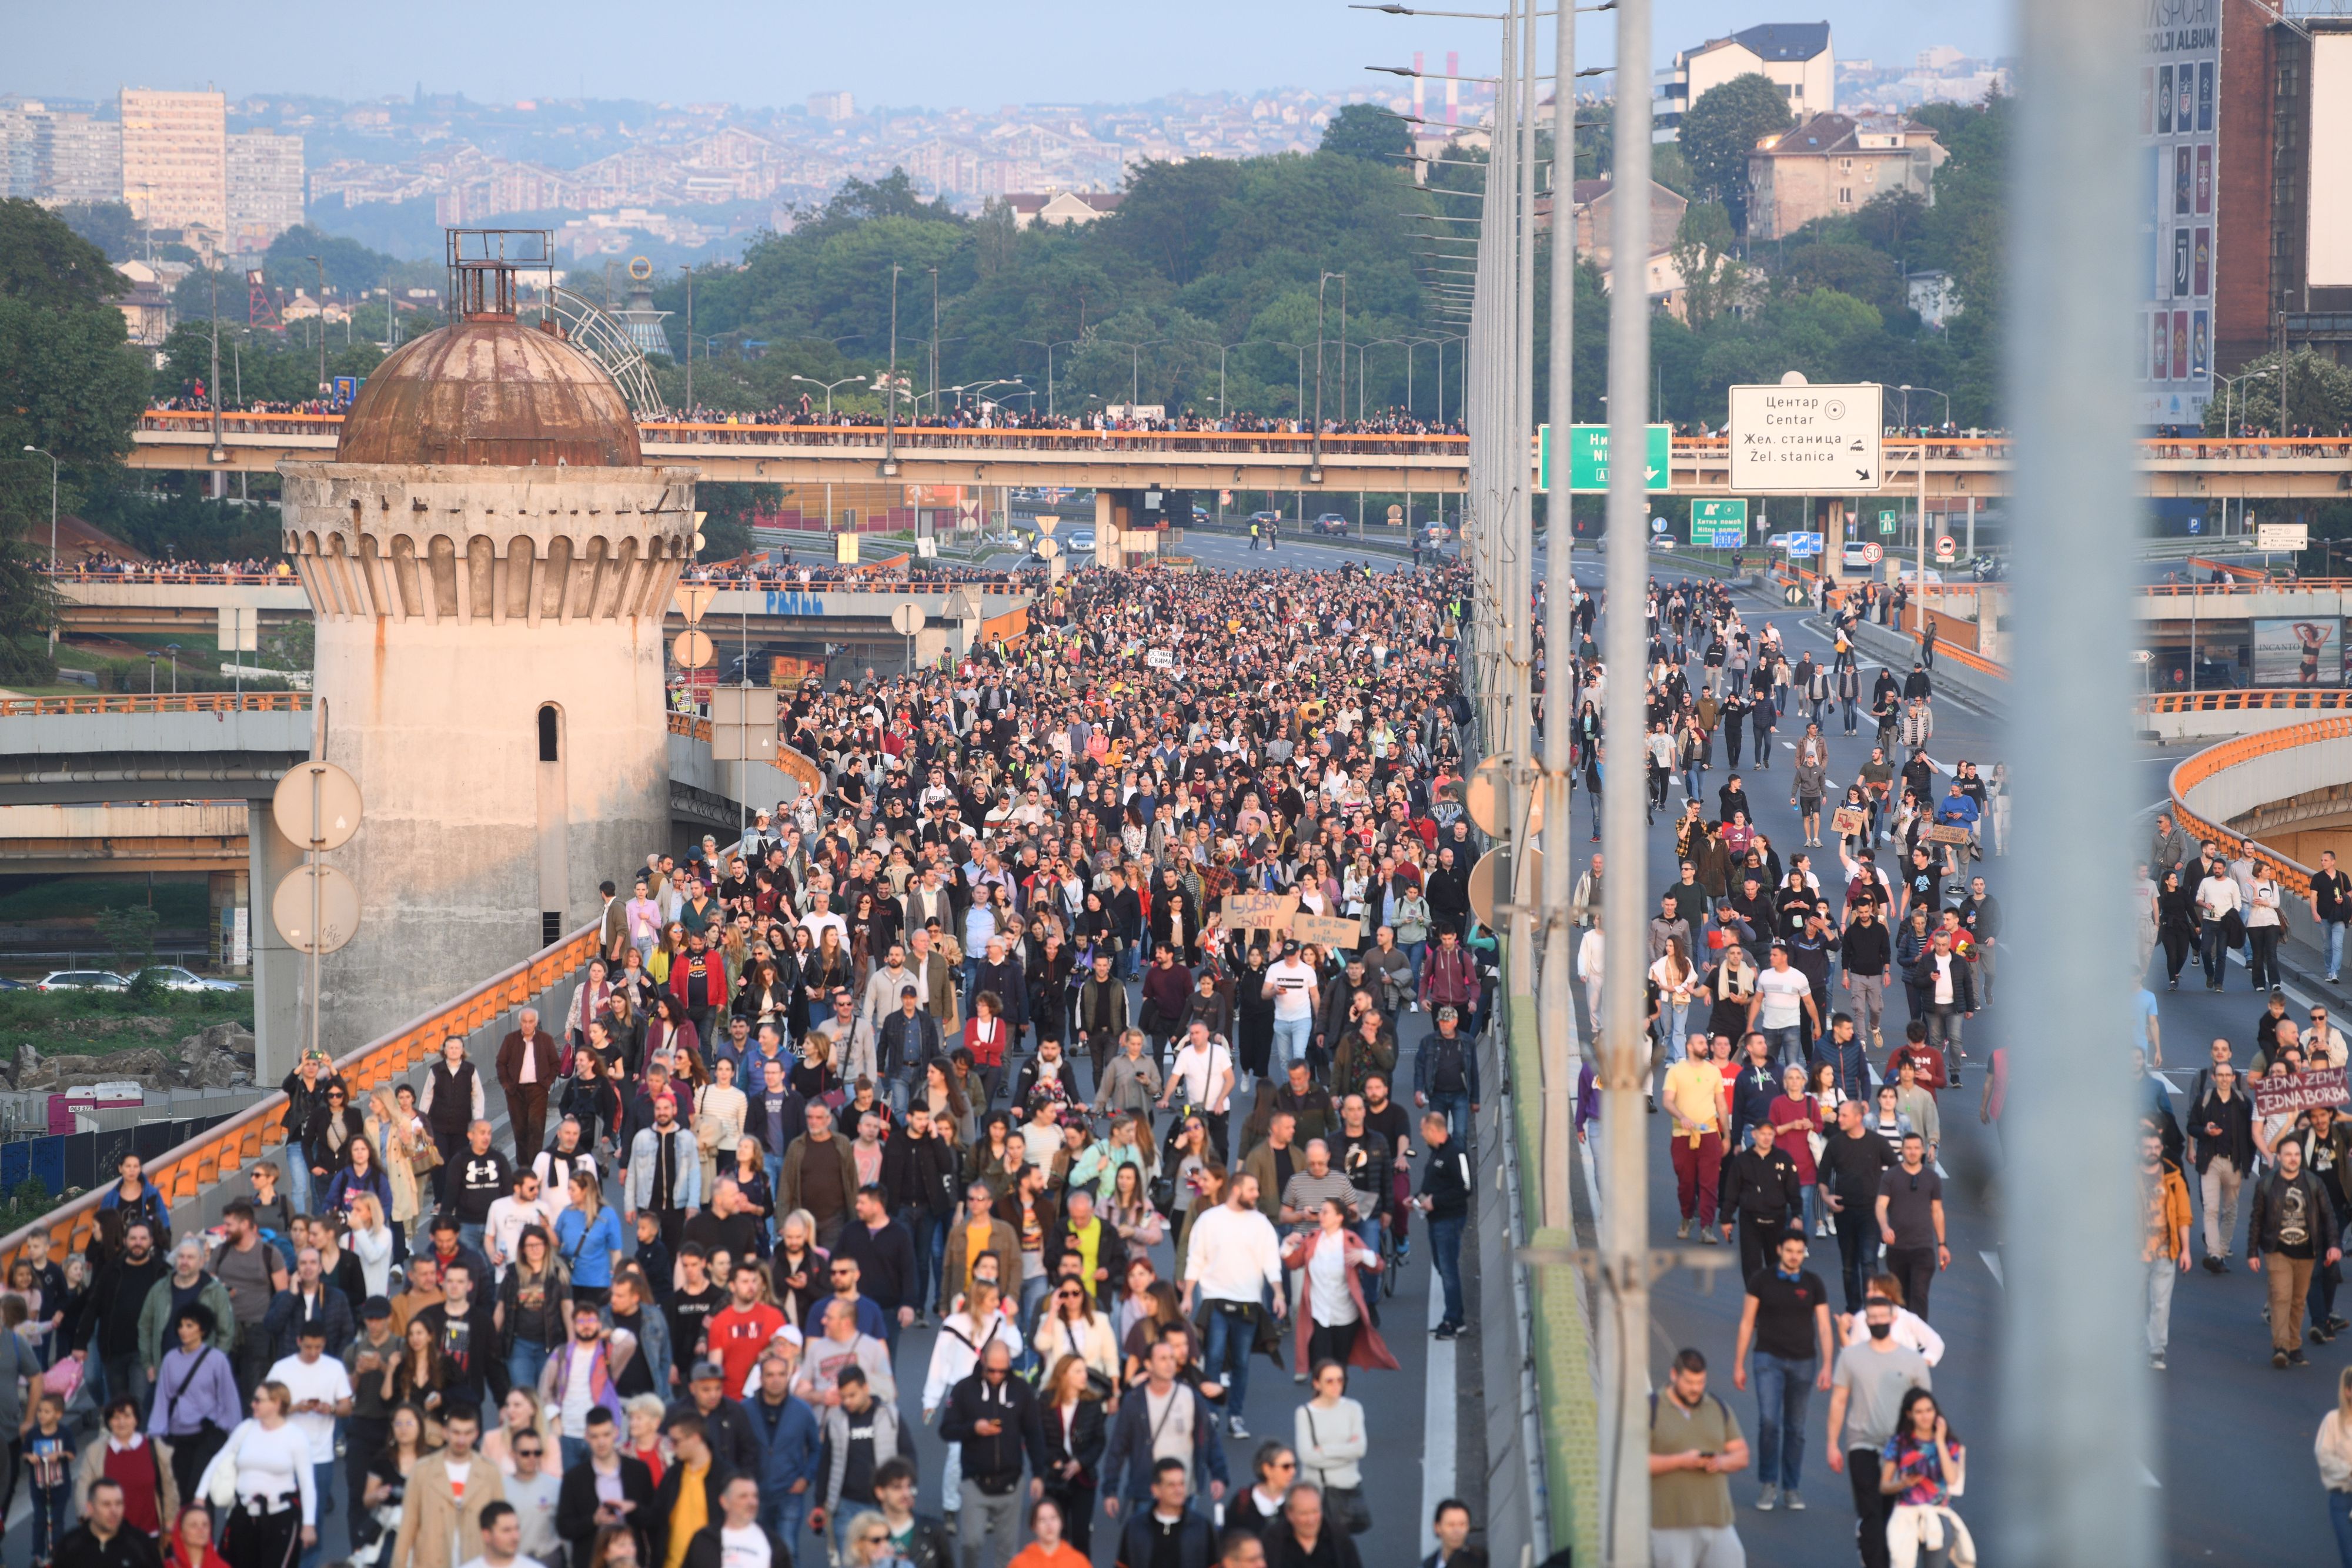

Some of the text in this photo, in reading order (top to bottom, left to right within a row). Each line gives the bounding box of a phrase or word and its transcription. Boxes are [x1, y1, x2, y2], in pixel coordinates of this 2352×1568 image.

[2177, 28, 2216, 51] ALBUM
[1766, 396, 1819, 409] Центар
[1766, 414, 1815, 424] Centar
[1590, 433, 1612, 445] Ни
[1744, 433, 1842, 445] Жел. станица
[1594, 450, 1612, 462] Ni
[1750, 449, 1834, 462] Žel. stanica
[2191, 519, 2197, 528] P
[1867, 548, 1879, 559] 50
[2254, 1074, 2302, 1093] JEDNA
[2257, 1086, 2351, 1114] JEDNA BORBA
